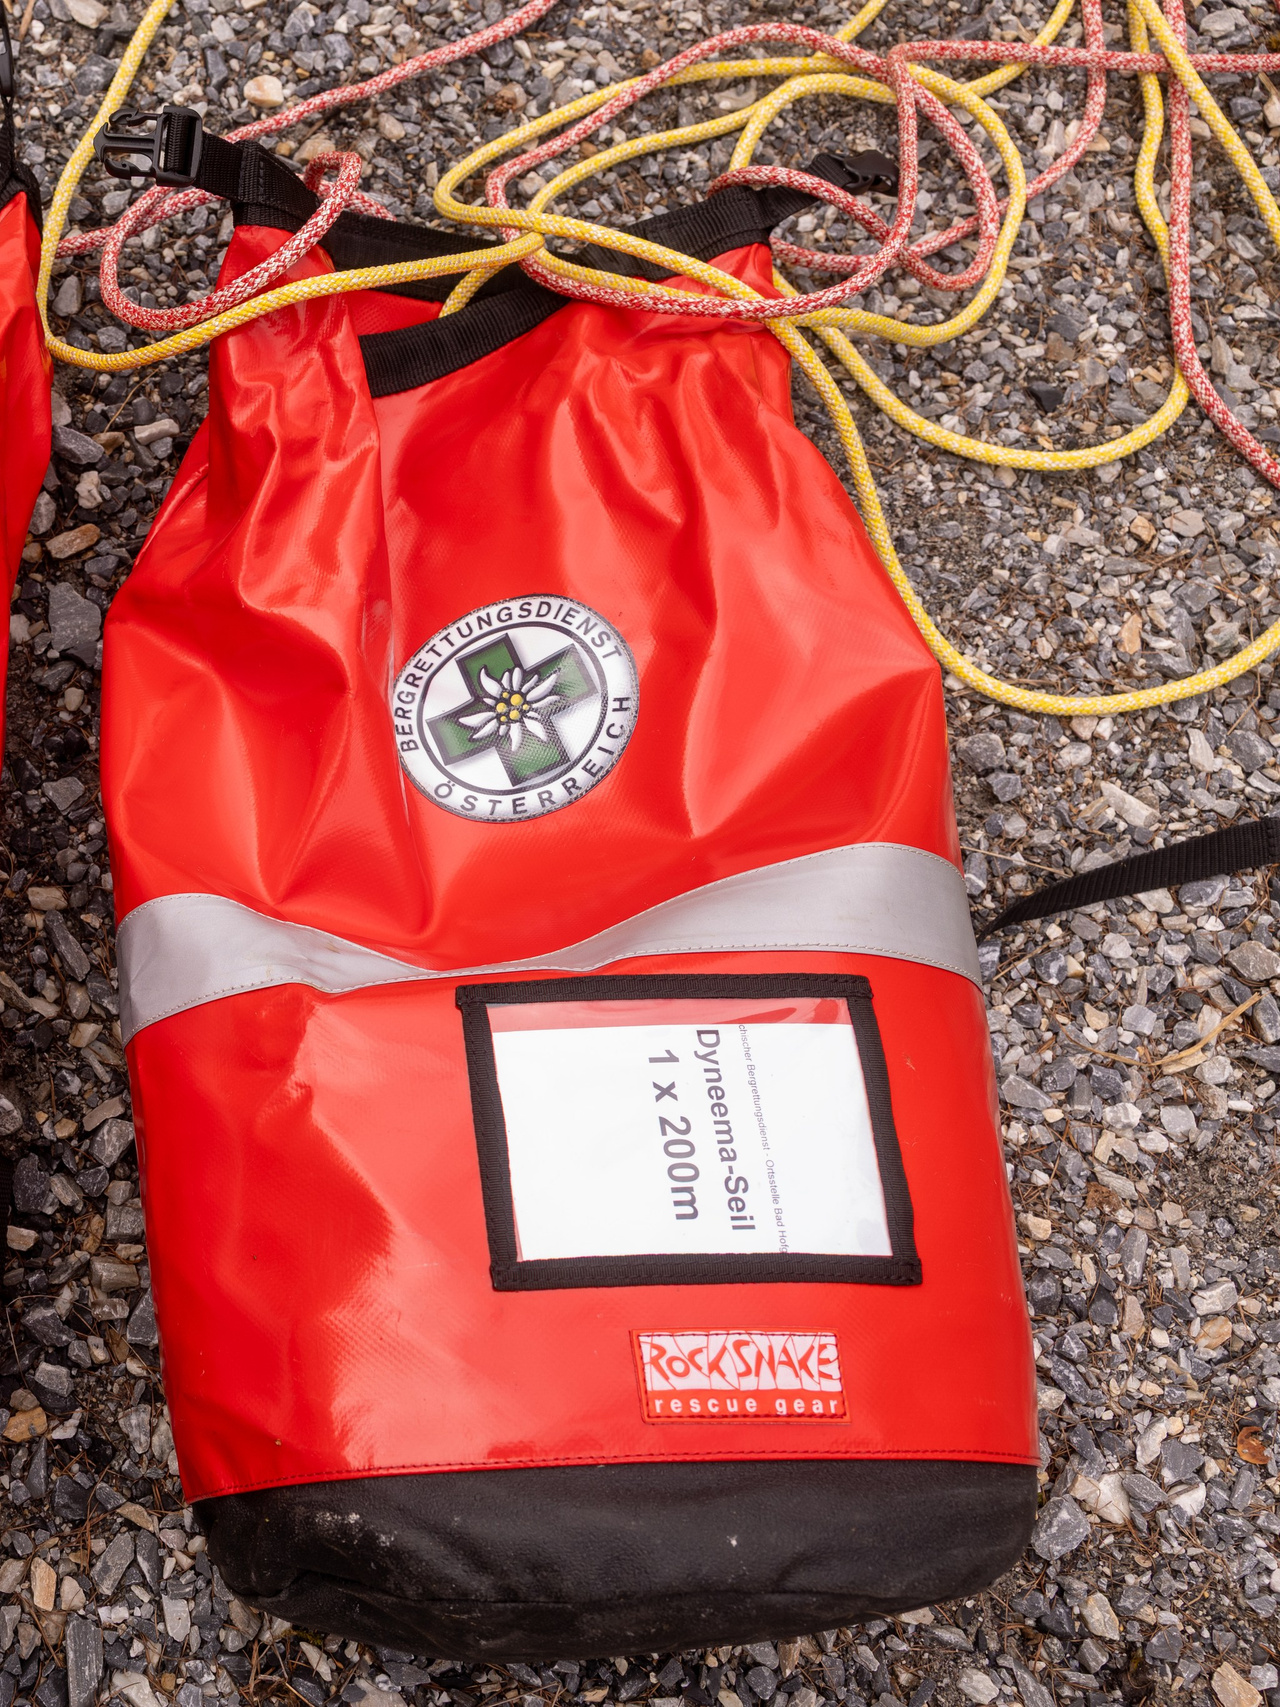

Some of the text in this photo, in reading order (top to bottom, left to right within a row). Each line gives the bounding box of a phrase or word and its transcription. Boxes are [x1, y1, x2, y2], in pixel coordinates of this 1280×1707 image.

[394, 600, 622, 753] BERGRETTUNGSDIENST
[434, 696, 631, 816] ÖSTERREICH
[648, 1049, 700, 1221] 1 x 200m
[693, 1029, 756, 1231] Dyneema-Seil
[747, 1063, 771, 1151] Bergrettungsdienst
[765, 1159, 780, 1205] Ortsstelle
[773, 1207, 785, 1227] Bad
[655, 1397, 838, 1415] rescue gear
